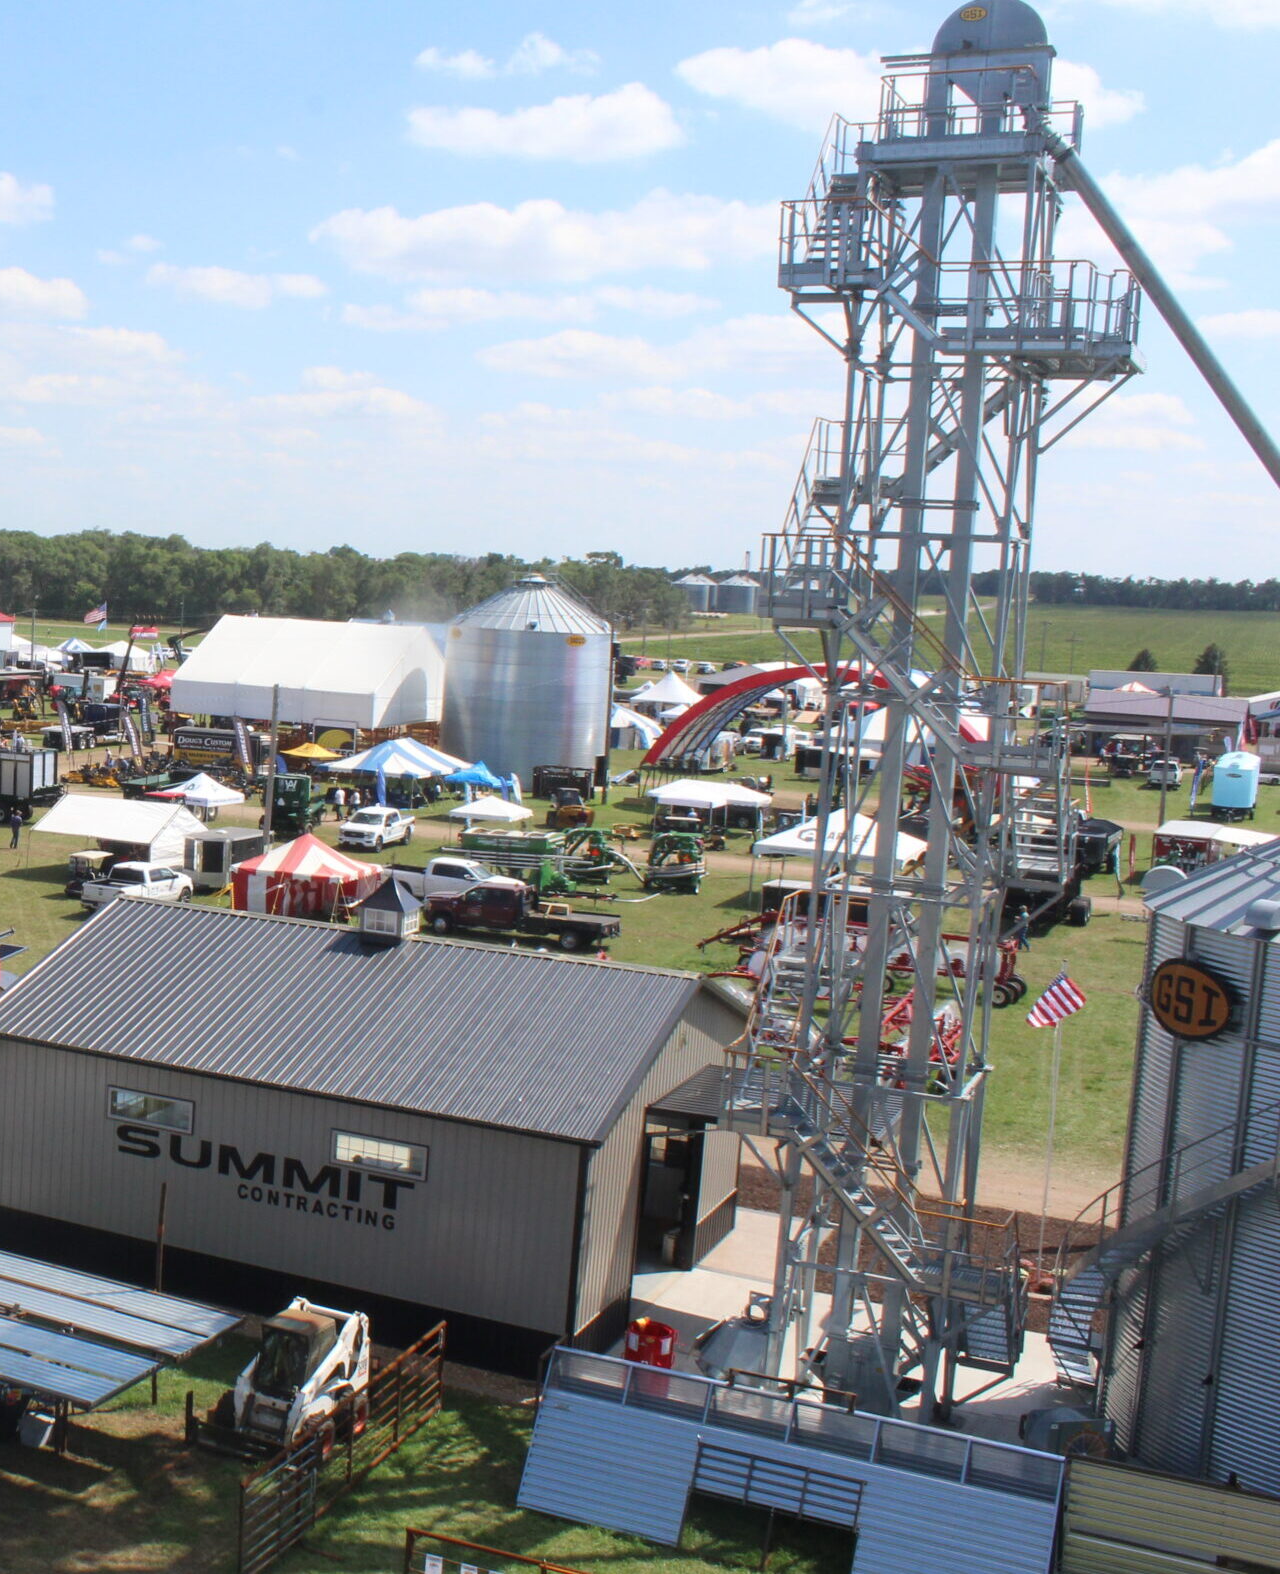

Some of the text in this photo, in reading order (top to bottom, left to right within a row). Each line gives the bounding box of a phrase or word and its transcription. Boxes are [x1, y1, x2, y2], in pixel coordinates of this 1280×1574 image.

[963, 8, 987, 19] GSI
[1157, 973, 1220, 1027] GSI
[116, 1124, 415, 1211] SUMMIT
[237, 1183, 396, 1231] CONTRACTING
